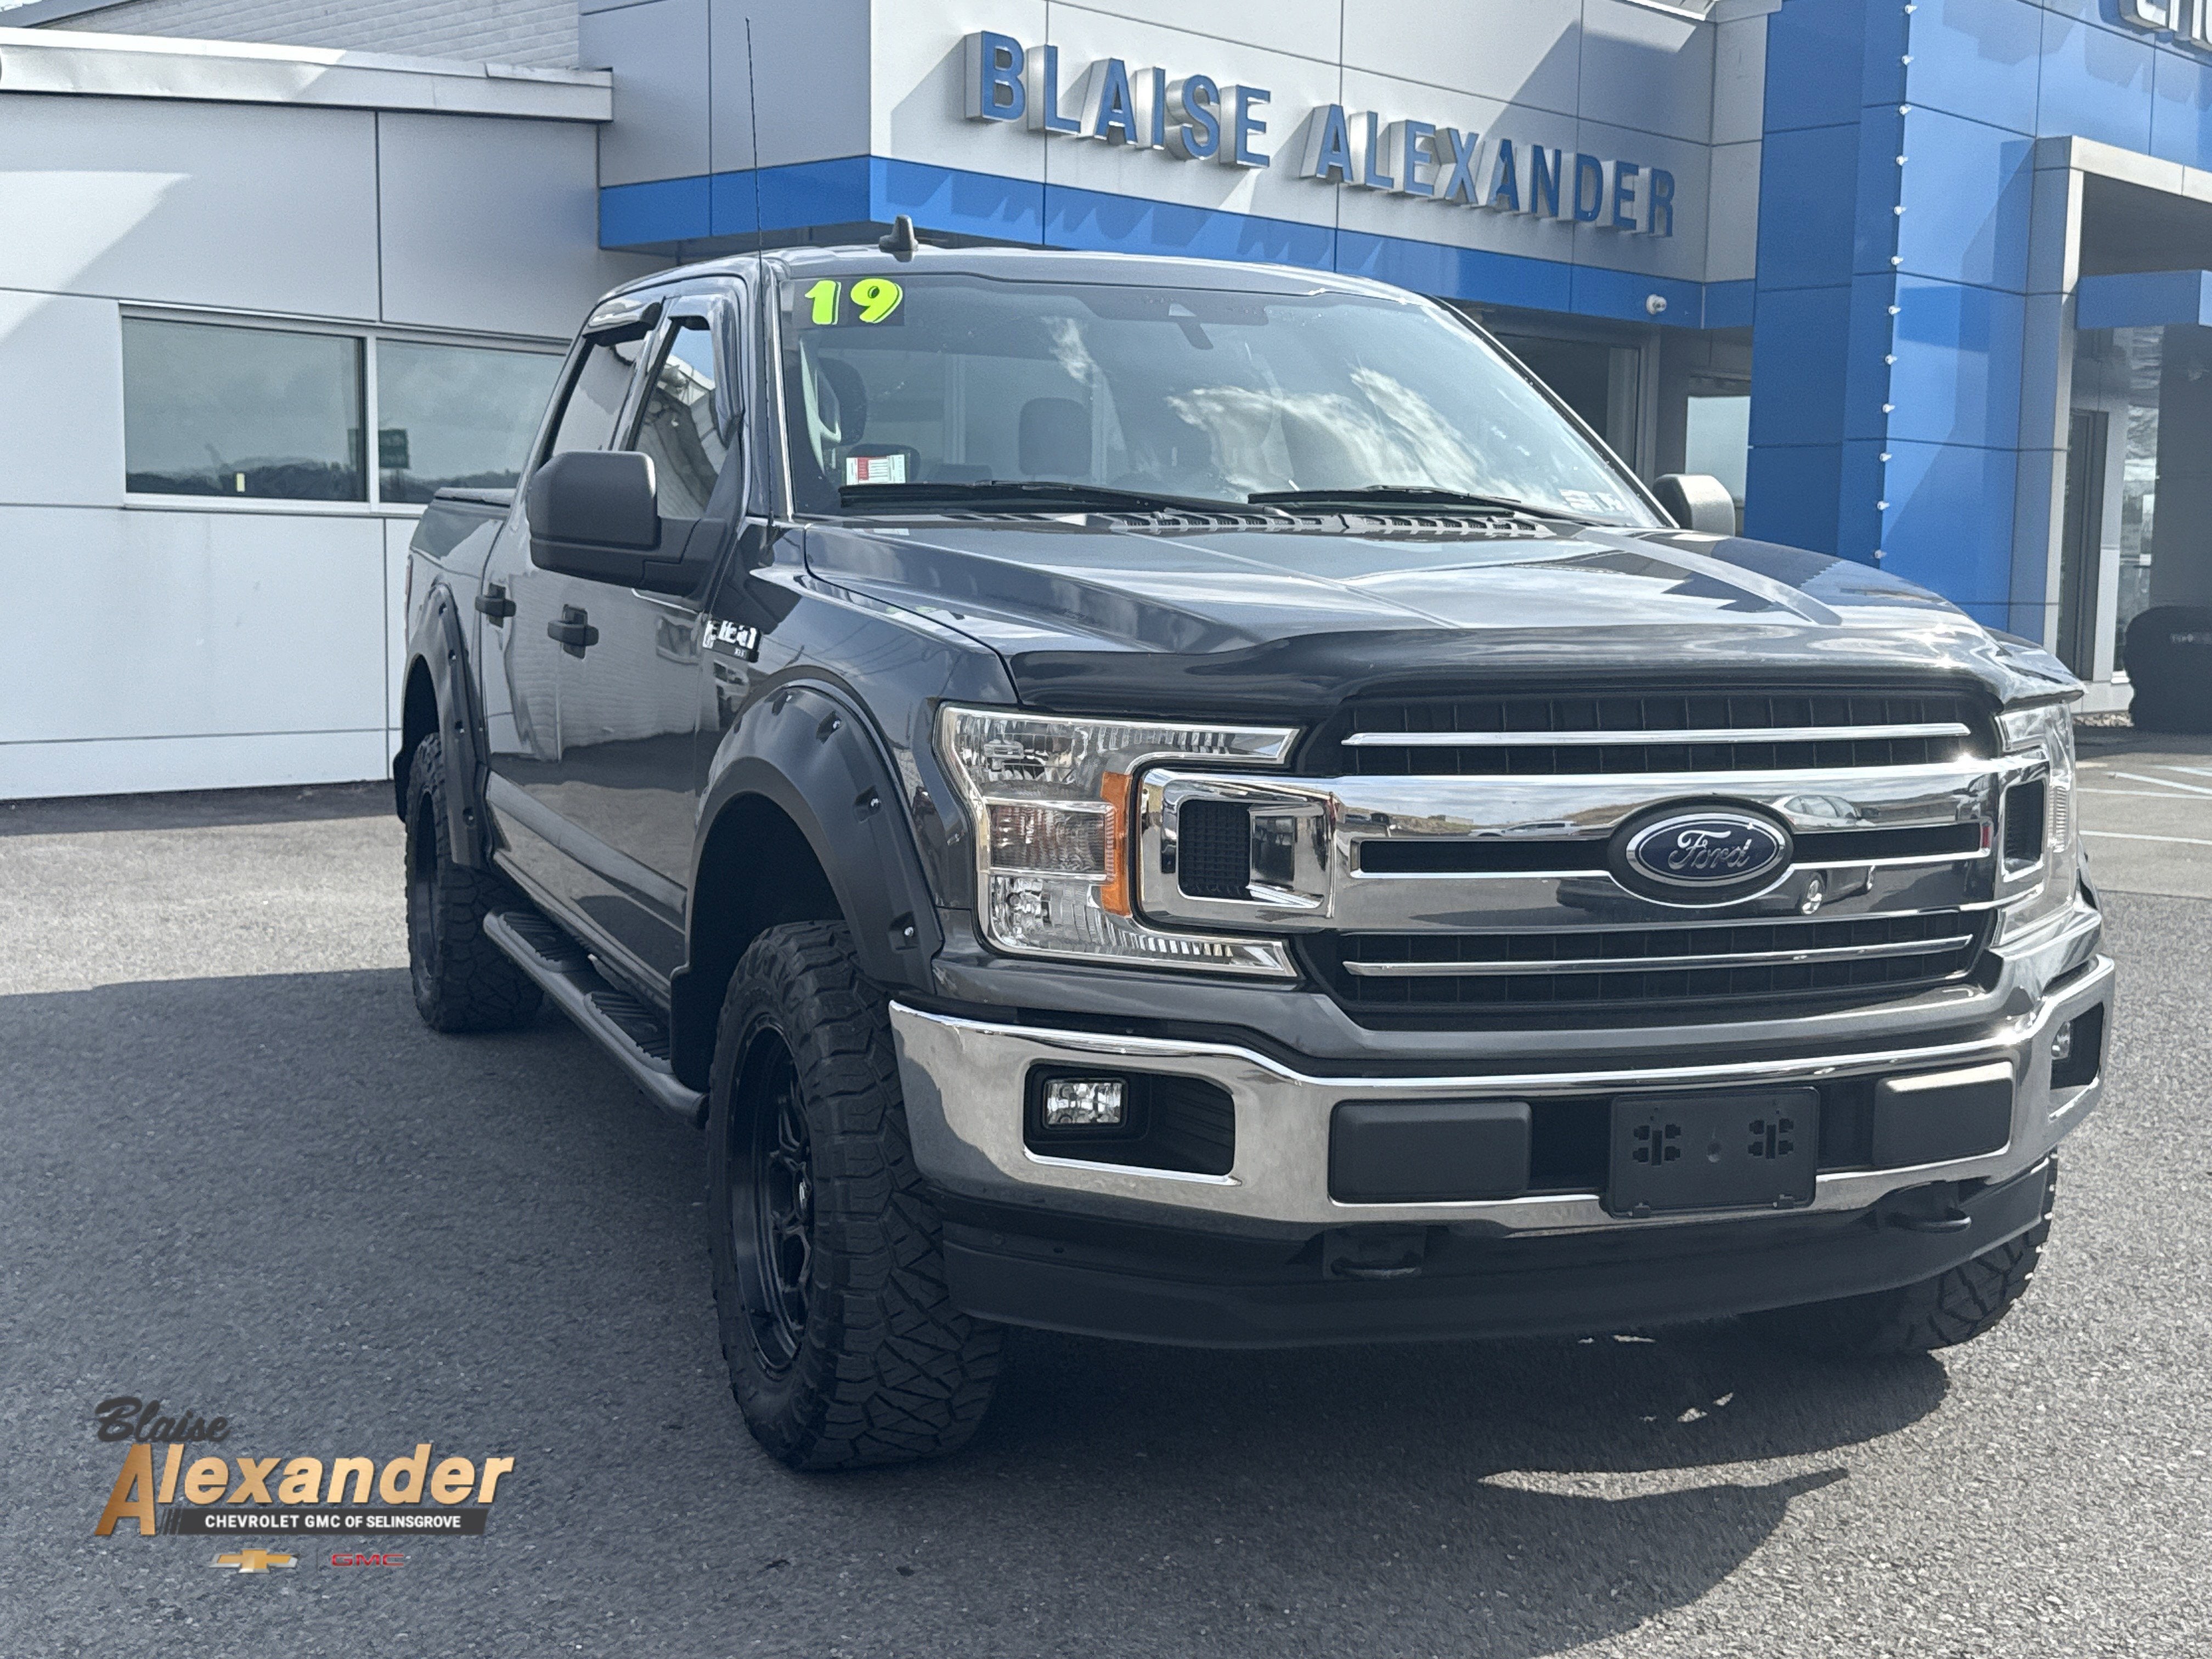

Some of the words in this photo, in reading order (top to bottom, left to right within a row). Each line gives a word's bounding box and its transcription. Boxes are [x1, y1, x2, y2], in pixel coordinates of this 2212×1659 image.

[980, 30, 1271, 169] BLAISE
[1314, 104, 1676, 238] ALEXANDER
[804, 278, 904, 325] 19
[1667, 830, 1752, 870] Ford
